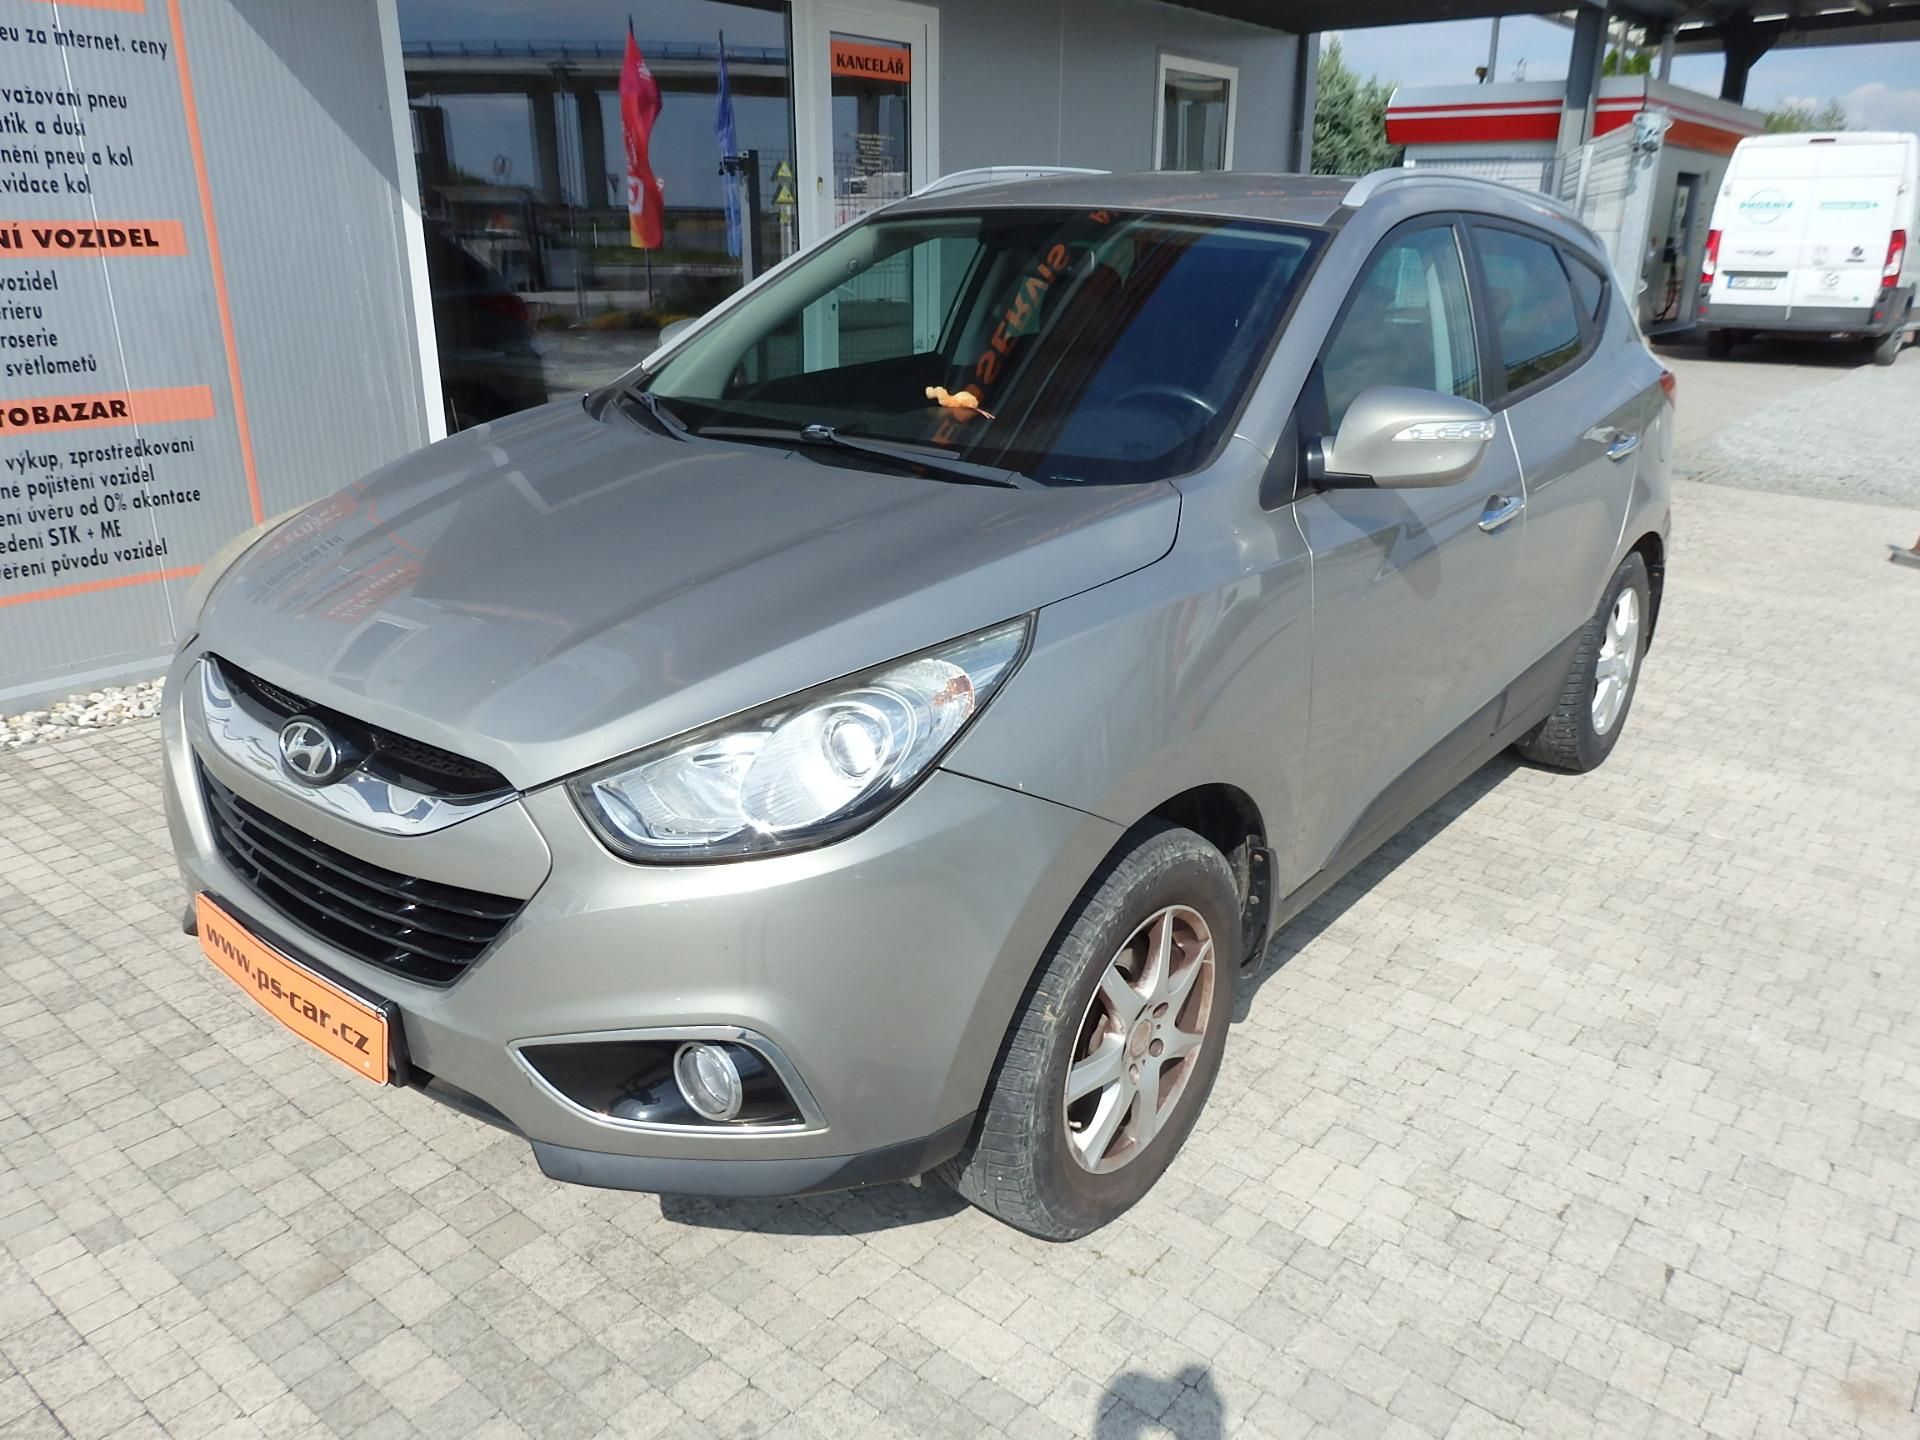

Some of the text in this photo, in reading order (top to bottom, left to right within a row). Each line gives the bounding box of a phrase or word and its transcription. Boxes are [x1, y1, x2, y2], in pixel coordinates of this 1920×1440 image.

[26, 29, 47, 44] za
[52, 24, 126, 51] internet.
[131, 38, 168, 60] ceny
[836, 53, 904, 75] KANCELÁŘ
[88, 92, 127, 112] pneu
[0, 112, 28, 134] tik
[35, 120, 46, 134] a
[45, 149, 85, 169] pneu
[92, 152, 102, 165] a
[106, 145, 133, 166] kol
[0, 172, 91, 193] vidace kol
[32, 228, 159, 249] VOZIDEL
[0, 300, 42, 320] riéru
[7, 354, 97, 377] světlometů
[6, 436, 195, 475] výkup, zprostředkování
[27, 472, 95, 501] pojištění
[100, 464, 155, 487] vozidel
[28, 505, 73, 523] úvěru
[80, 496, 98, 516] od
[104, 493, 127, 513] 0%
[133, 488, 201, 509] akontace
[49, 525, 81, 547] STK
[101, 519, 122, 539] ME
[51, 547, 109, 577] původu
[114, 538, 168, 562] vozidel
[206, 923, 370, 1056] www.ps-car.cz
